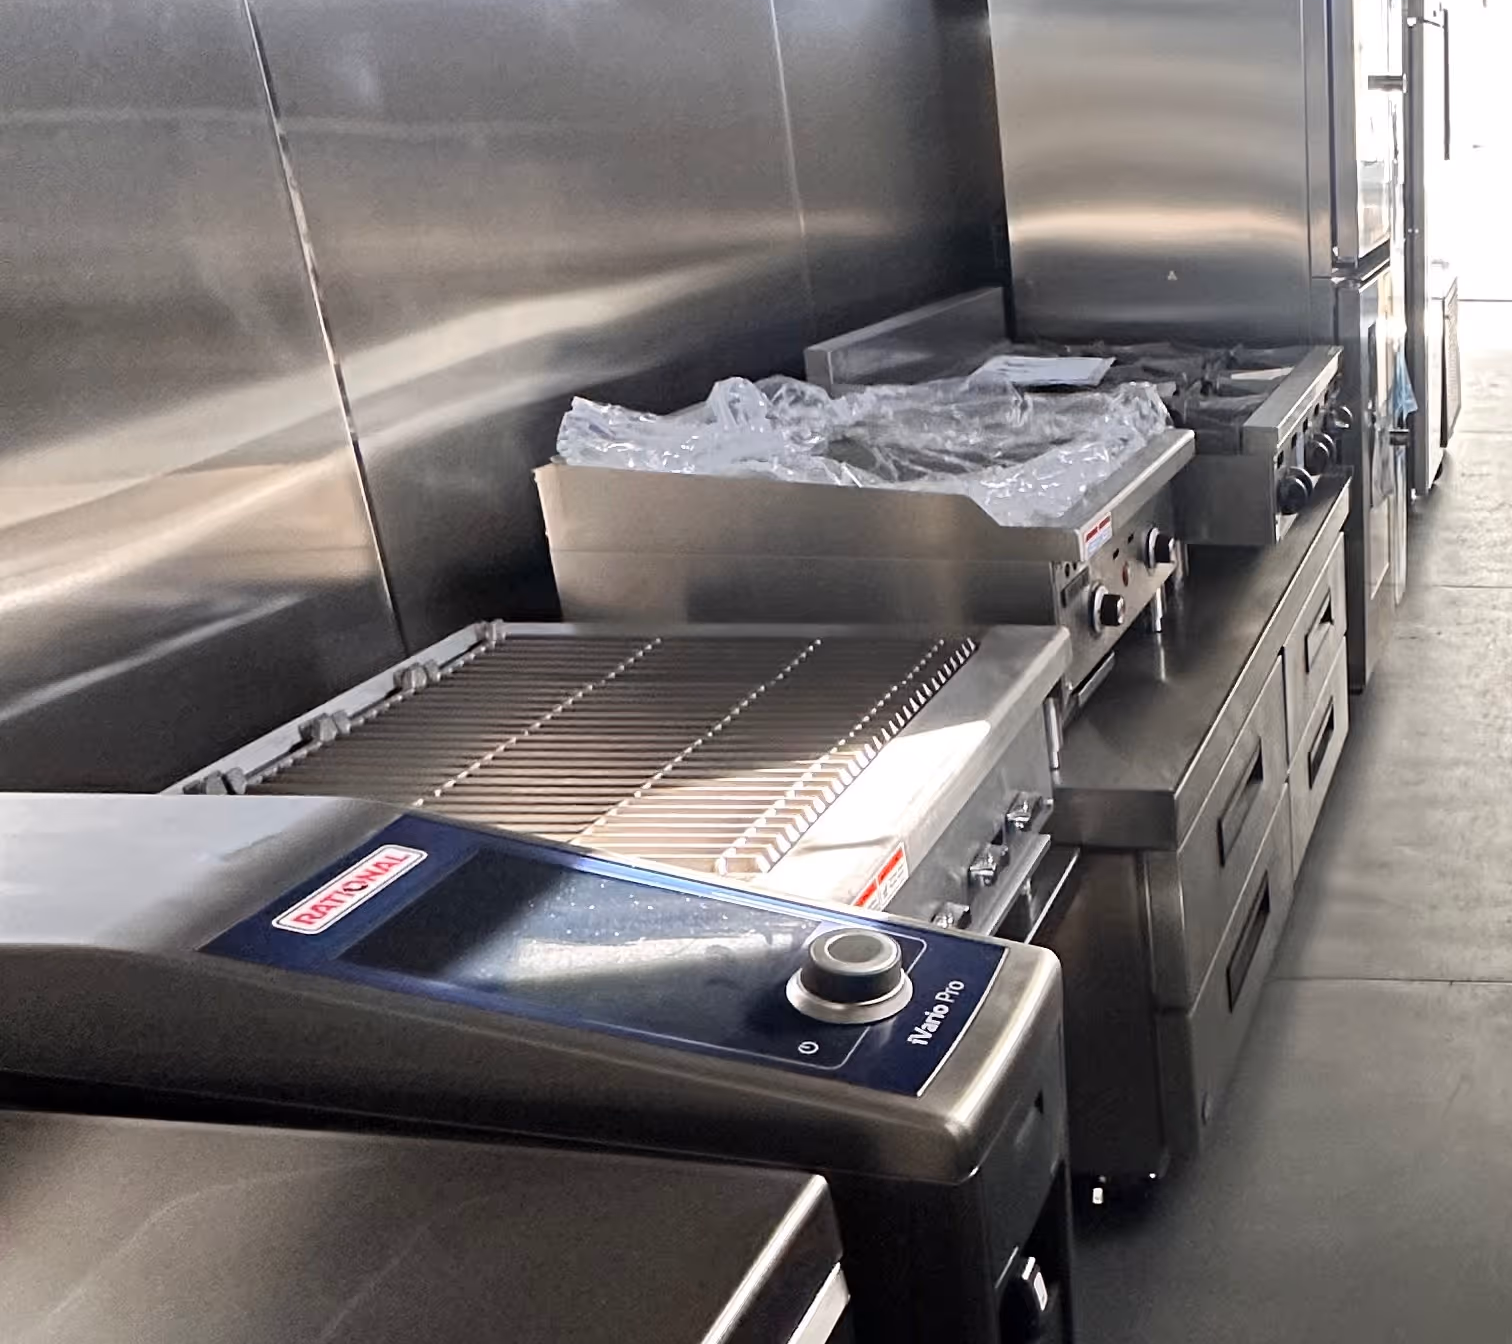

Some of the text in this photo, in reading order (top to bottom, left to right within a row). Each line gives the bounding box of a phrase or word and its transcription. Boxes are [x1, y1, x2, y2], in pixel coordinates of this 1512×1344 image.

[293, 854, 411, 925] RATIONAL
[907, 980, 965, 1045] iVario Pro
